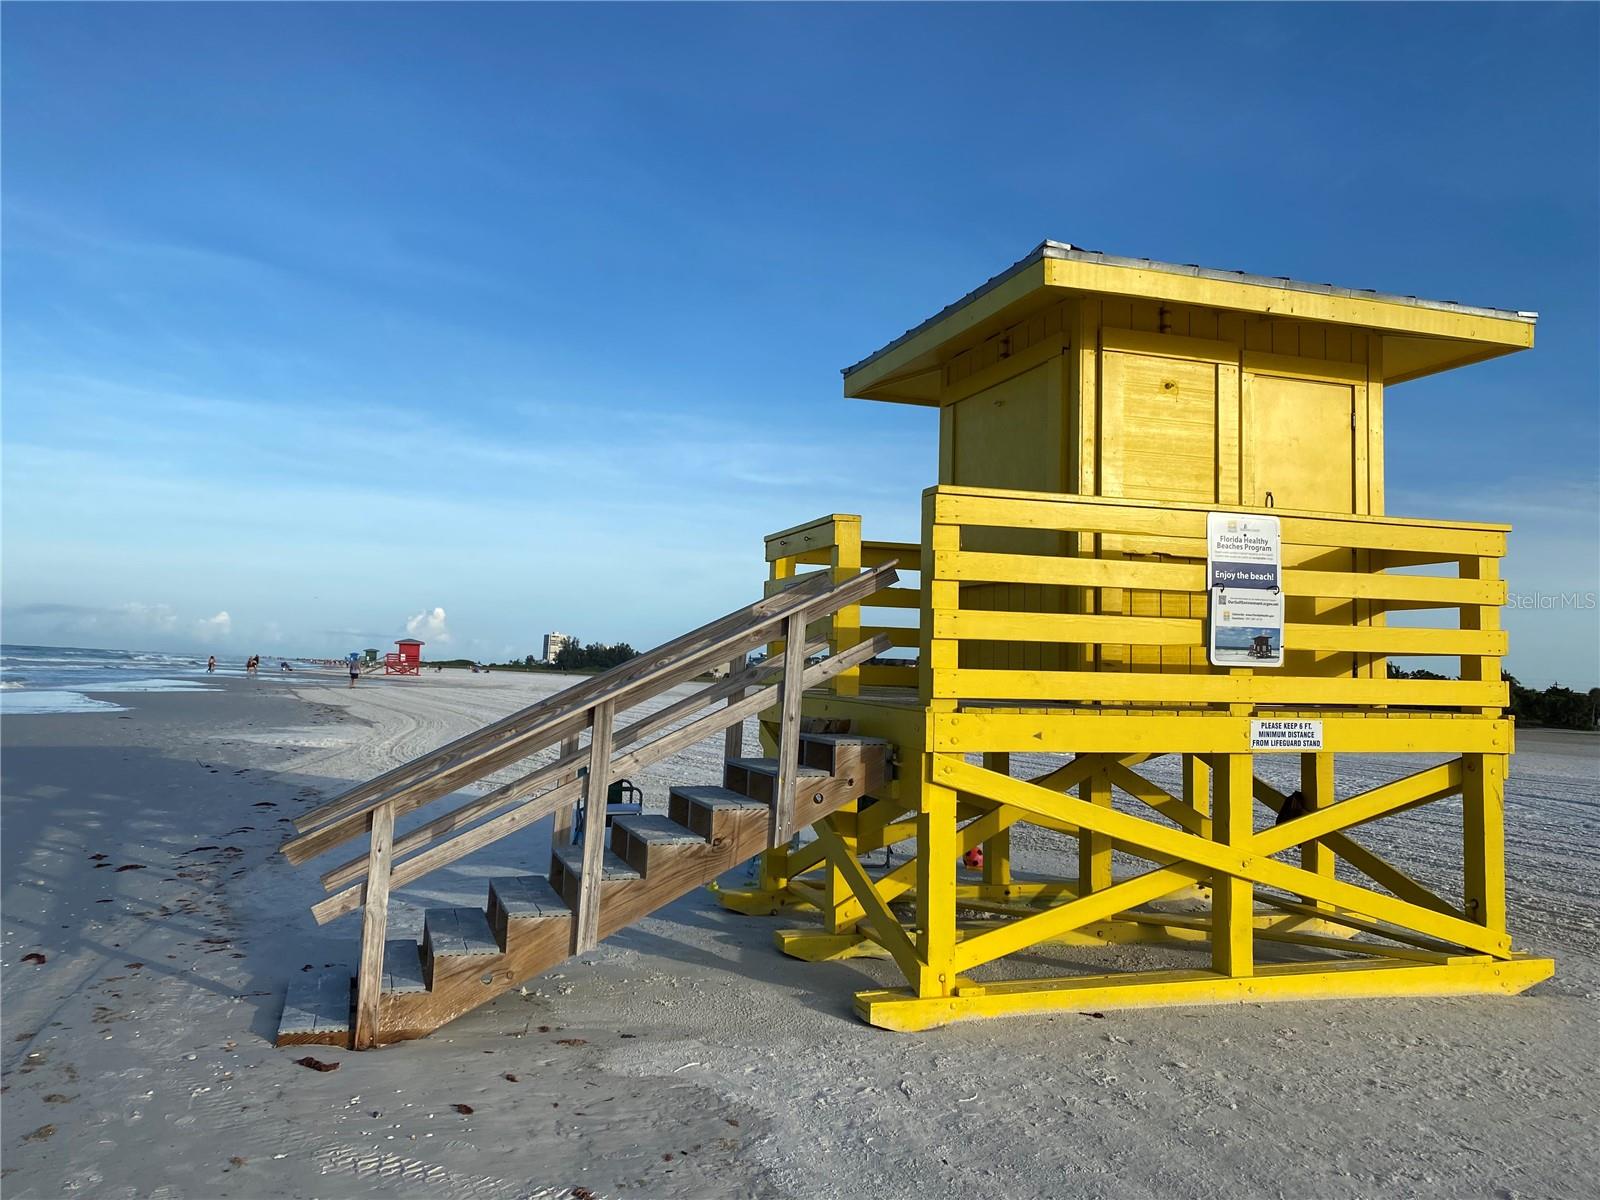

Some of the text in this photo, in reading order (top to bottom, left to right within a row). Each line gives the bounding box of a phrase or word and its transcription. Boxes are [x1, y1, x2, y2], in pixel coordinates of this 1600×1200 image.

[1244, 536, 1268, 545] Healthy
[1217, 542, 1272, 552] Beaches Program
[1215, 570, 1236, 580] Enjoy
[1250, 572, 1274, 580] beach!
